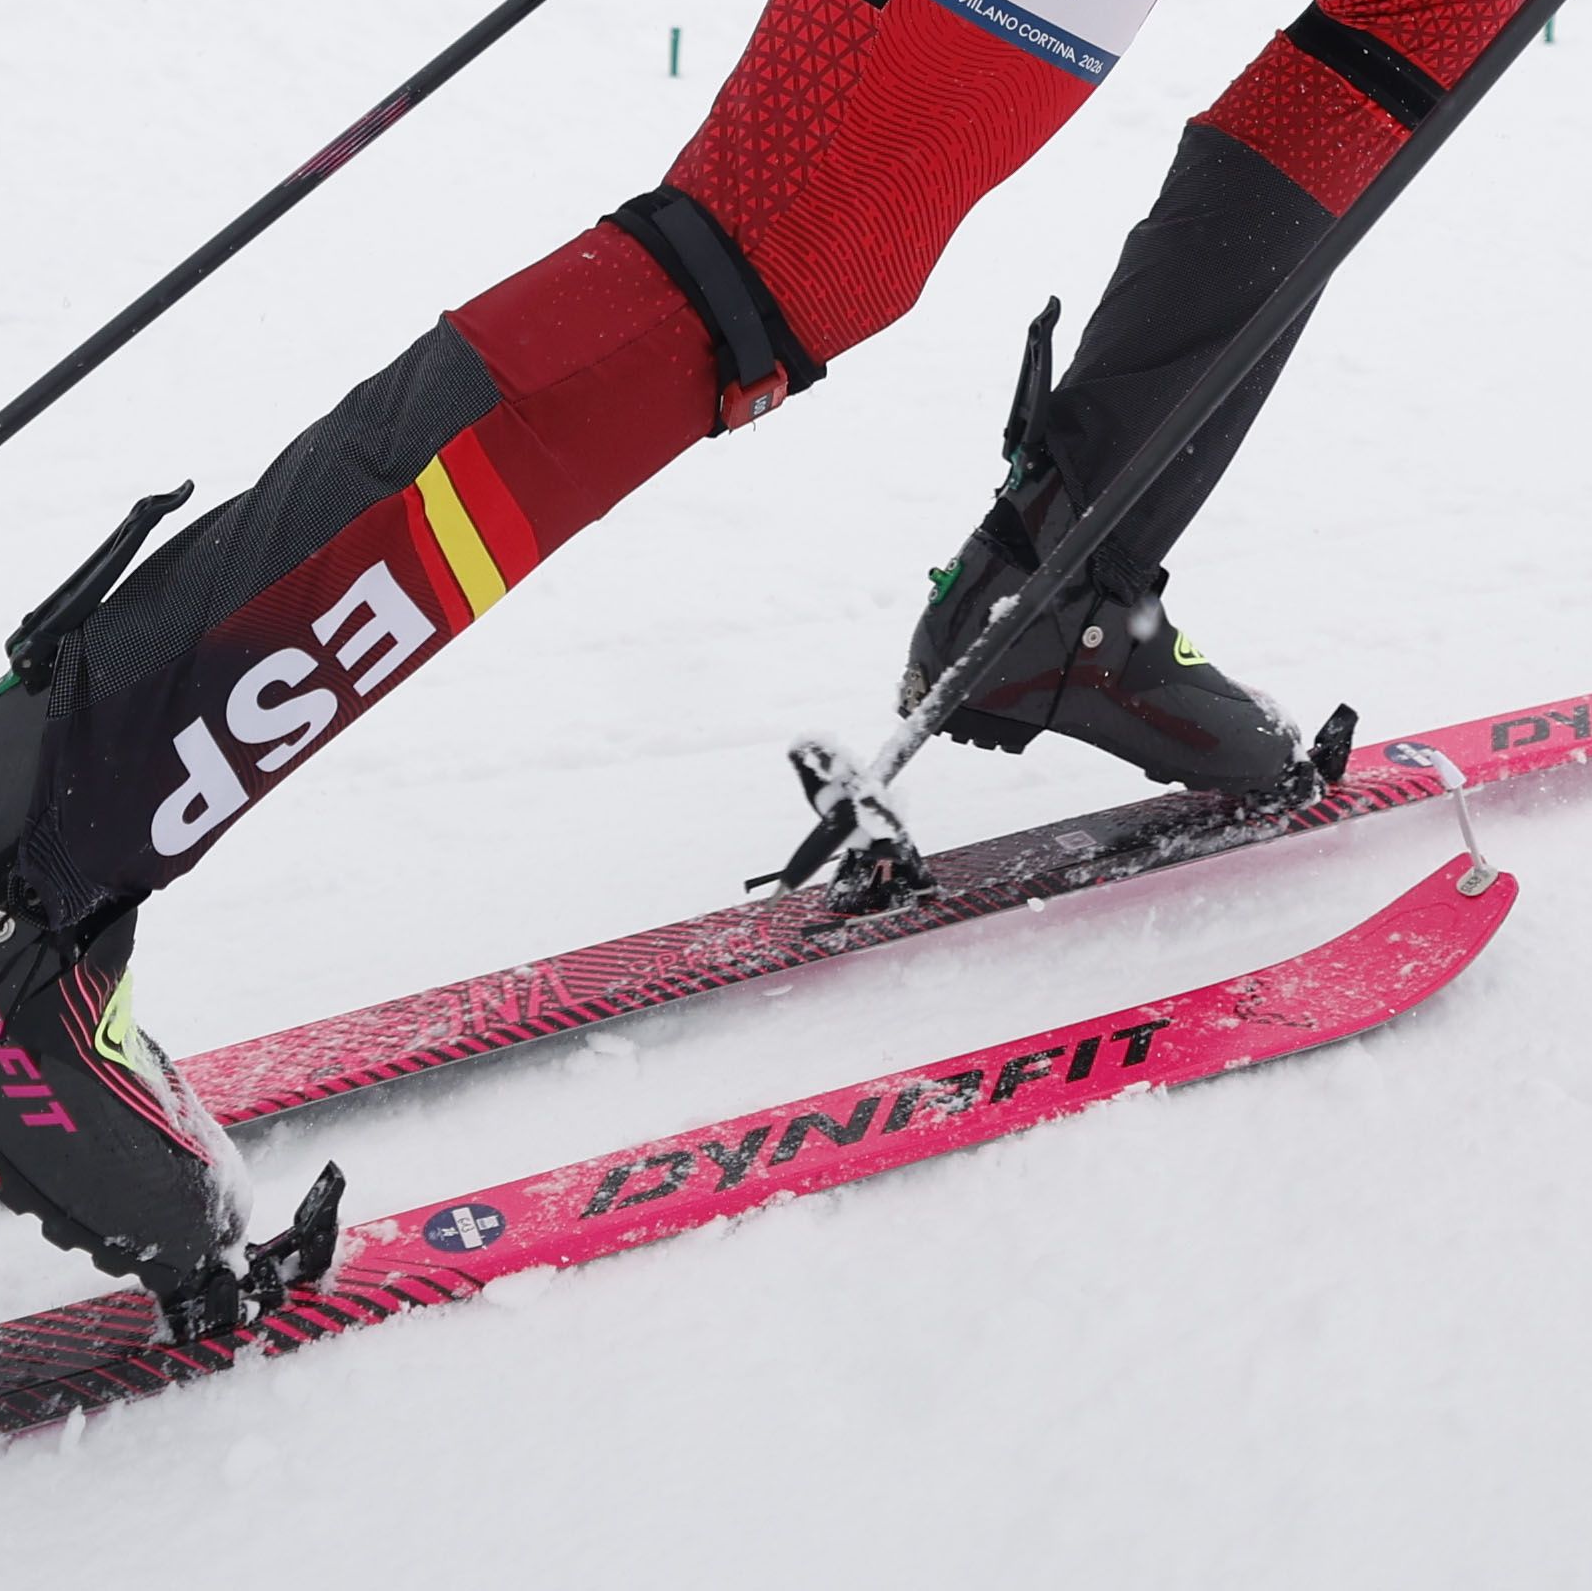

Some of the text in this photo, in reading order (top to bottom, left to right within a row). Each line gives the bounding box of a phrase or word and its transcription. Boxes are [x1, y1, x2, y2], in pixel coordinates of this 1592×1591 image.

[1018, 23, 1076, 64] CORTINA
[1078, 54, 1104, 75] 2026
[150, 559, 437, 858] ESP
[580, 1017, 1172, 1220] DYNAFIT
